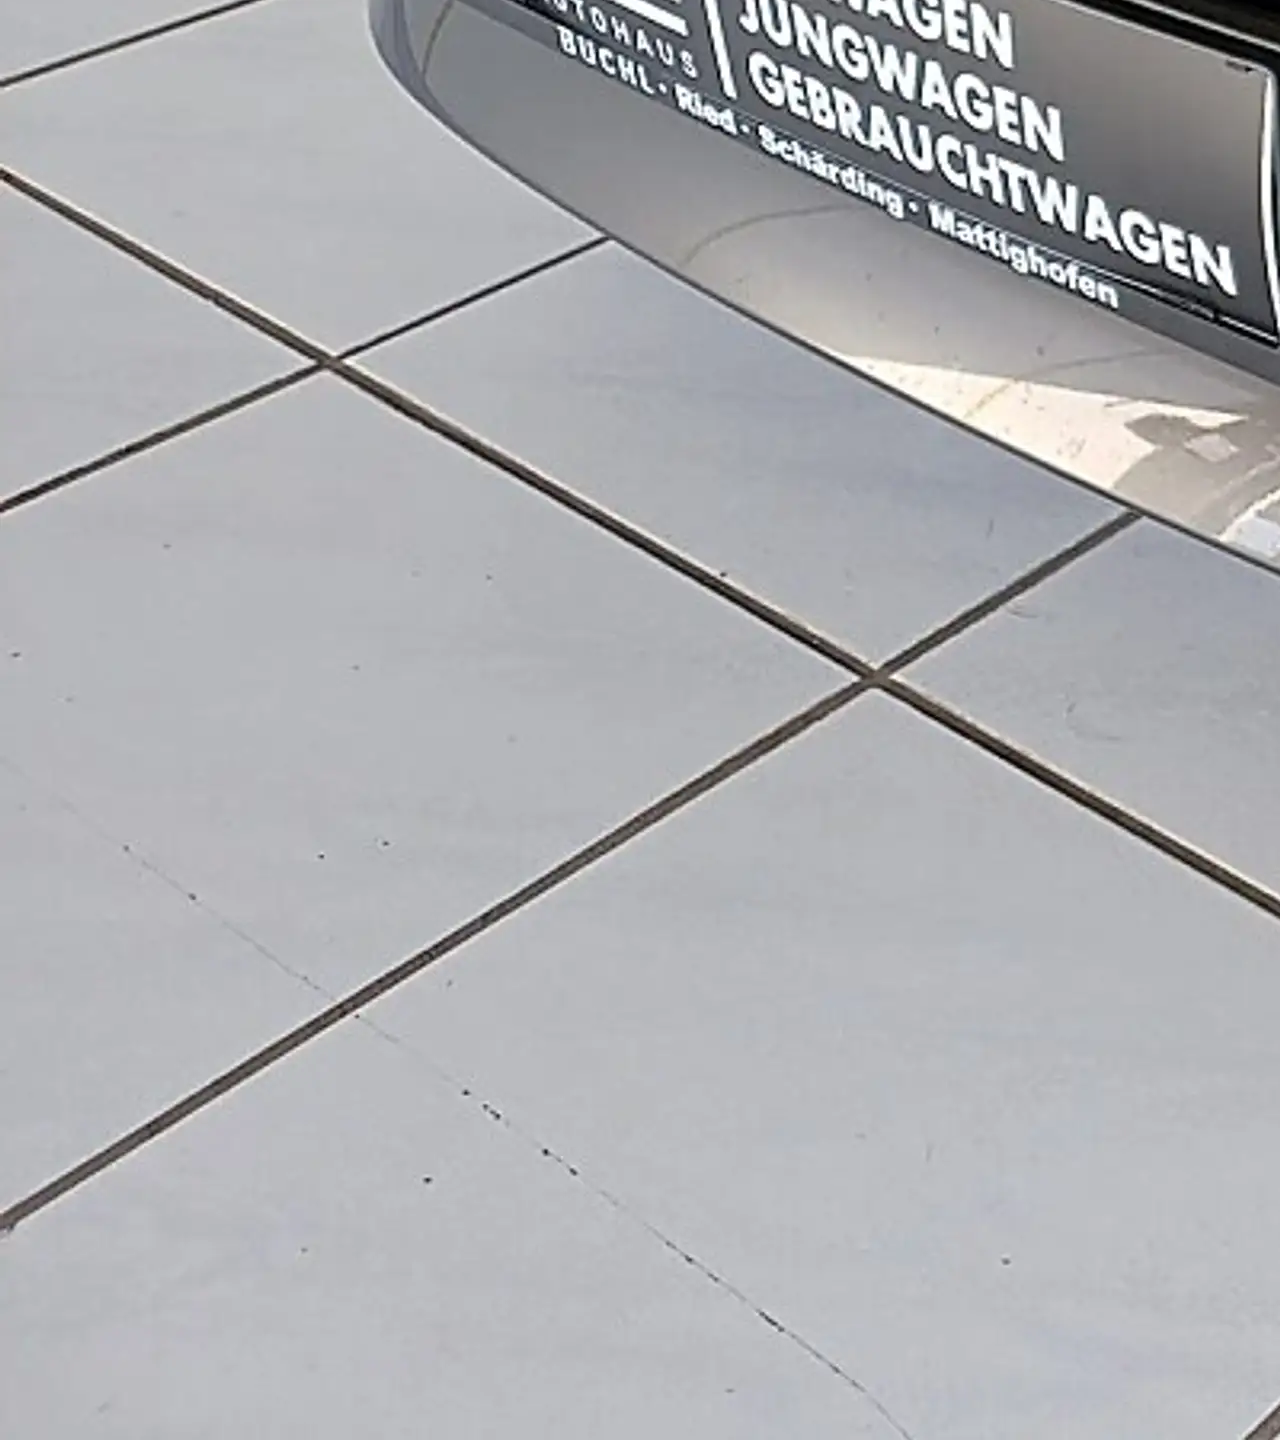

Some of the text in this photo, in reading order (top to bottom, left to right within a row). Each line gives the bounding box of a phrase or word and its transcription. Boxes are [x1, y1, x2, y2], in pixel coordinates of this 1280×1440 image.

[674, 82, 739, 136] Ried
[756, 124, 905, 219] Schärding
[928, 200, 1120, 310] Mattighofen
[747, 51, 1238, 296] GEBRAUCHTWAGEN
